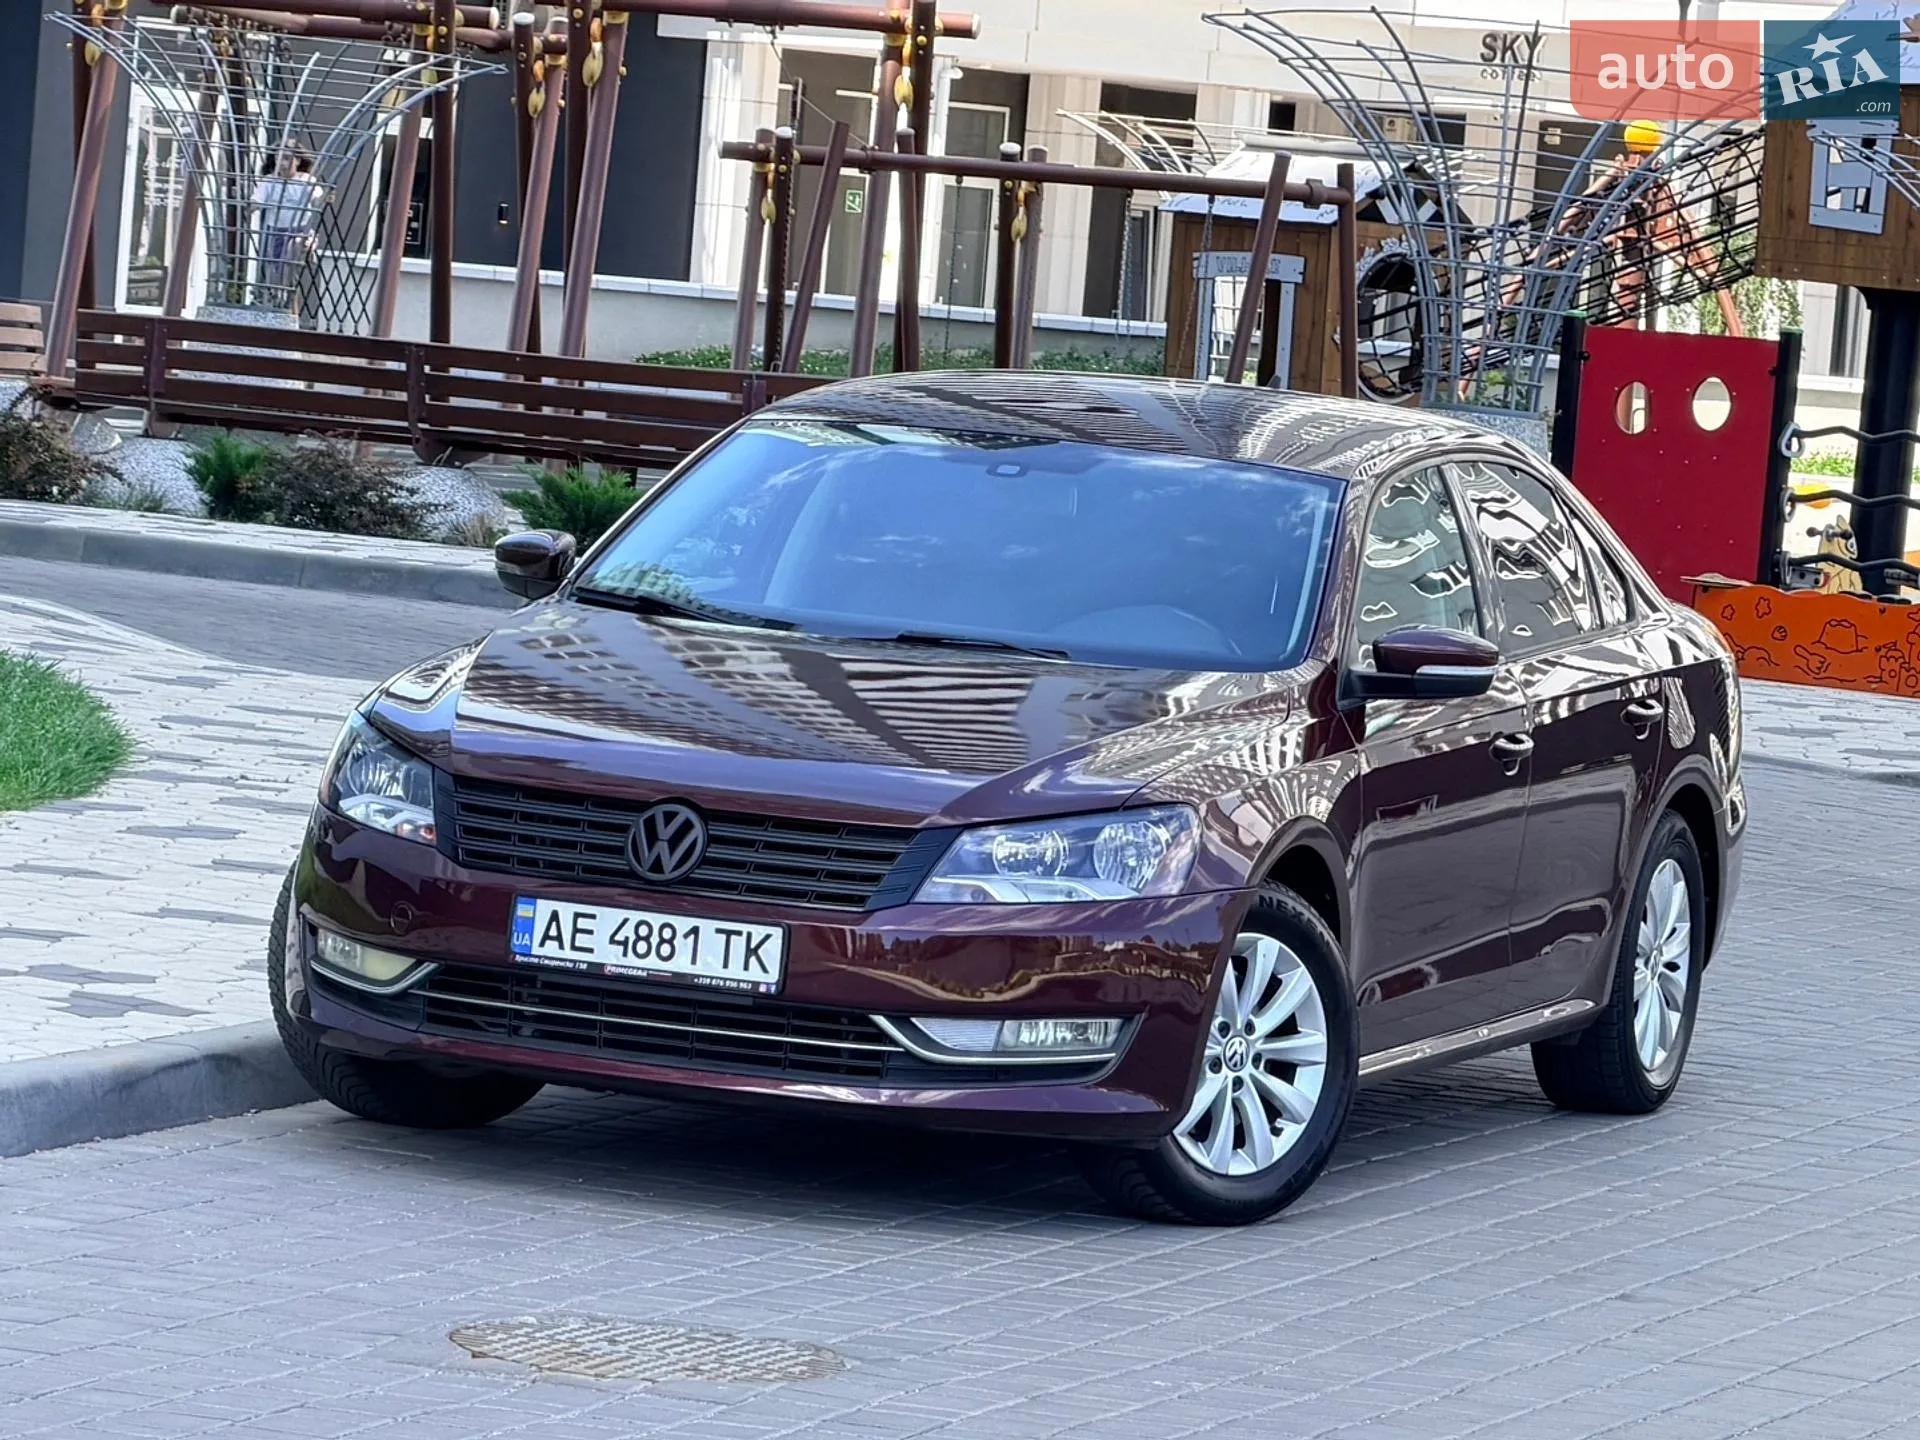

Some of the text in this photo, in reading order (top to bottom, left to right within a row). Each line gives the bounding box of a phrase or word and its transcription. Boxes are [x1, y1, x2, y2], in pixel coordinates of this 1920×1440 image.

[1481, 33, 1543, 63] SKY
[513, 932, 531, 946] UA
[539, 909, 773, 974] AE 4881 TK
